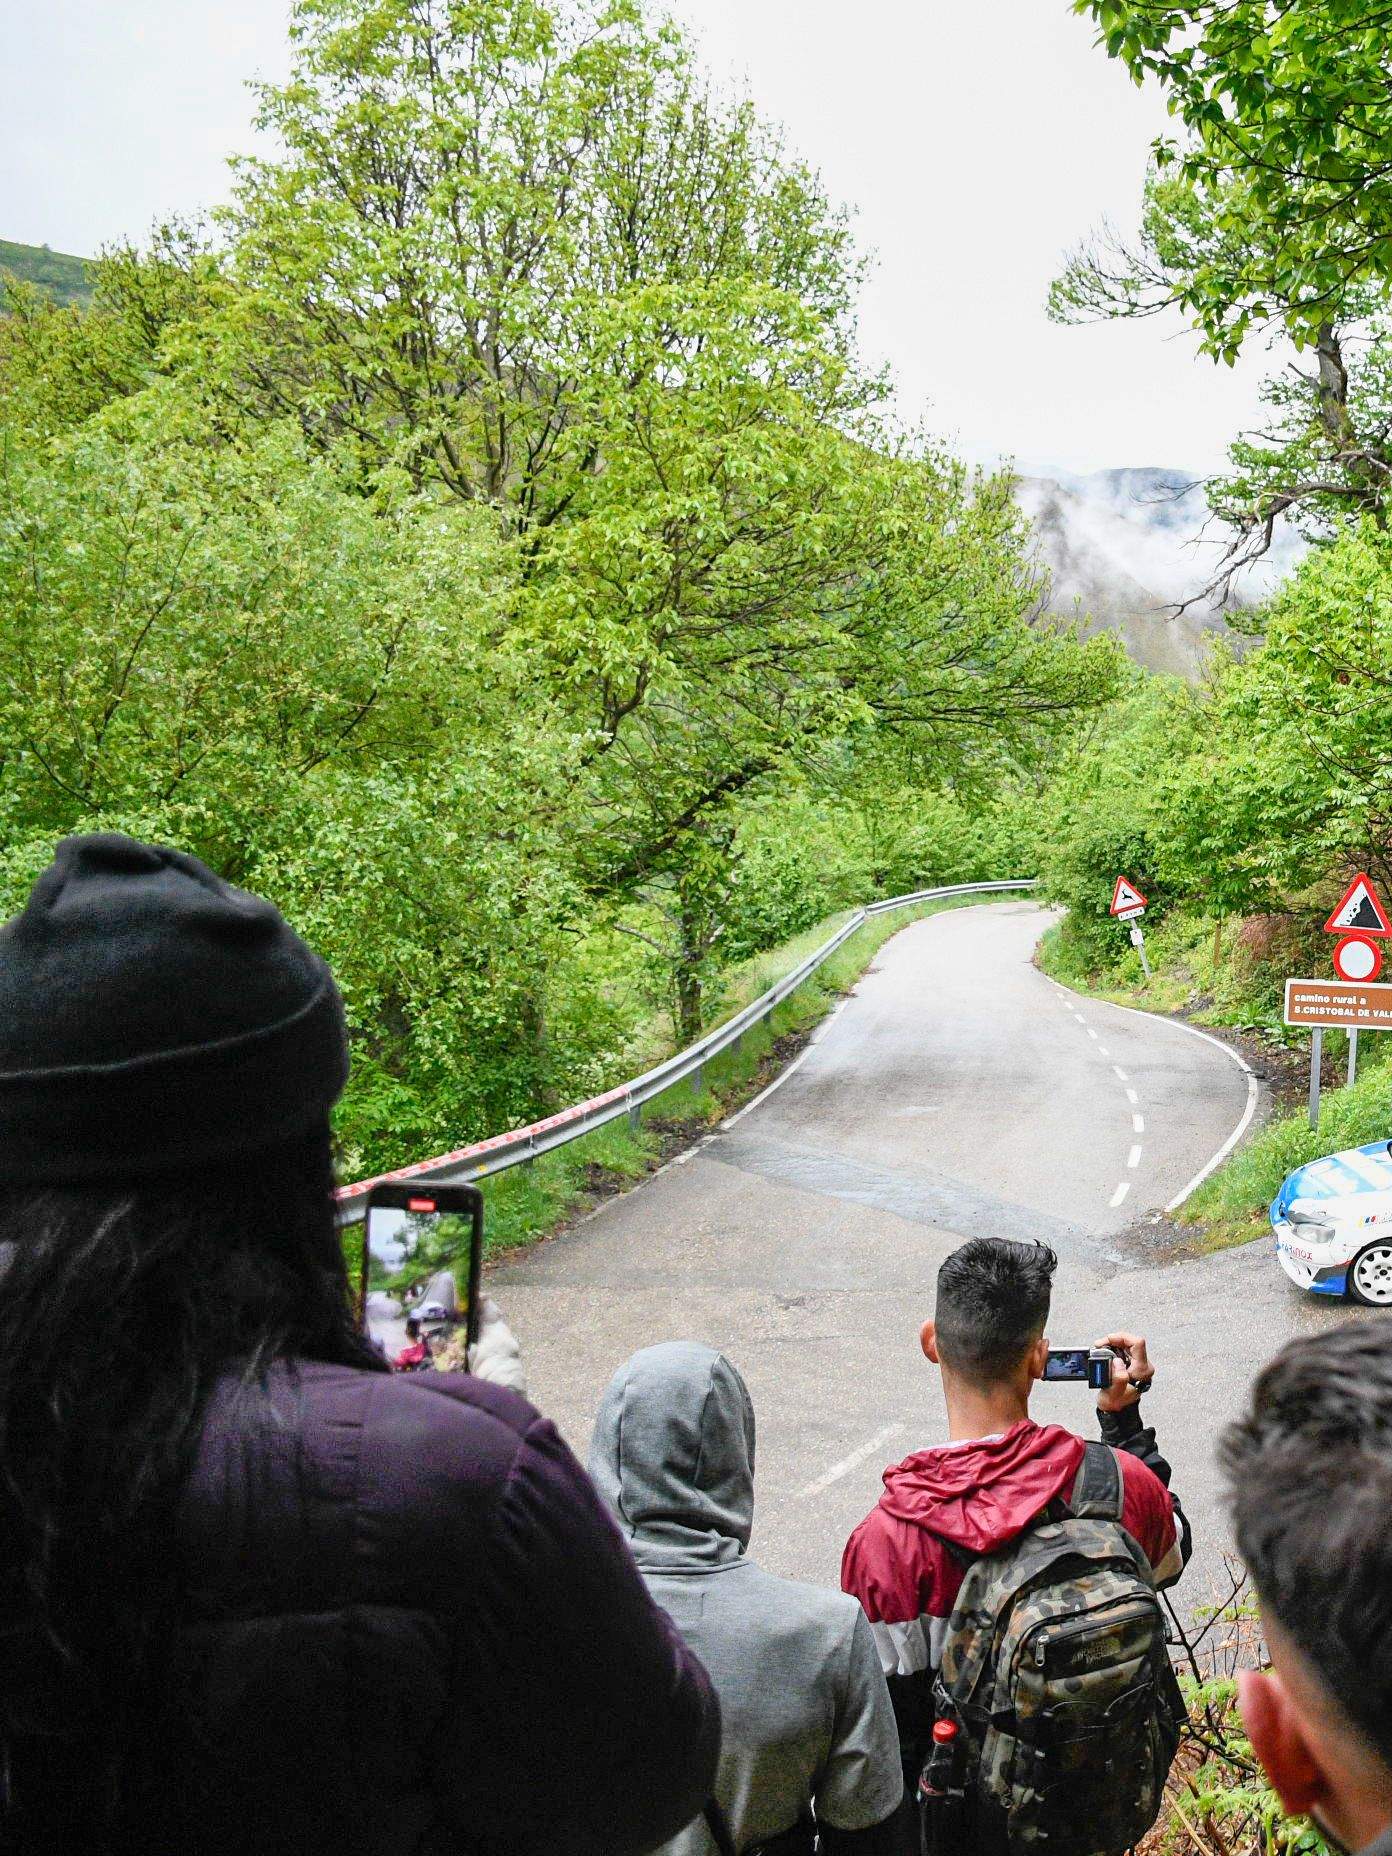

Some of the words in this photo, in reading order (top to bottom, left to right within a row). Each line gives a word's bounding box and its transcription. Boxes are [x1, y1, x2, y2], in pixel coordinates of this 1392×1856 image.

[1294, 994, 1331, 1003] camino
[1332, 996, 1357, 1005] rural
[1360, 997, 1367, 1005] a
[1294, 1006, 1355, 1017] S.CRISTOBAL
[1357, 1009, 1370, 1018] DE
